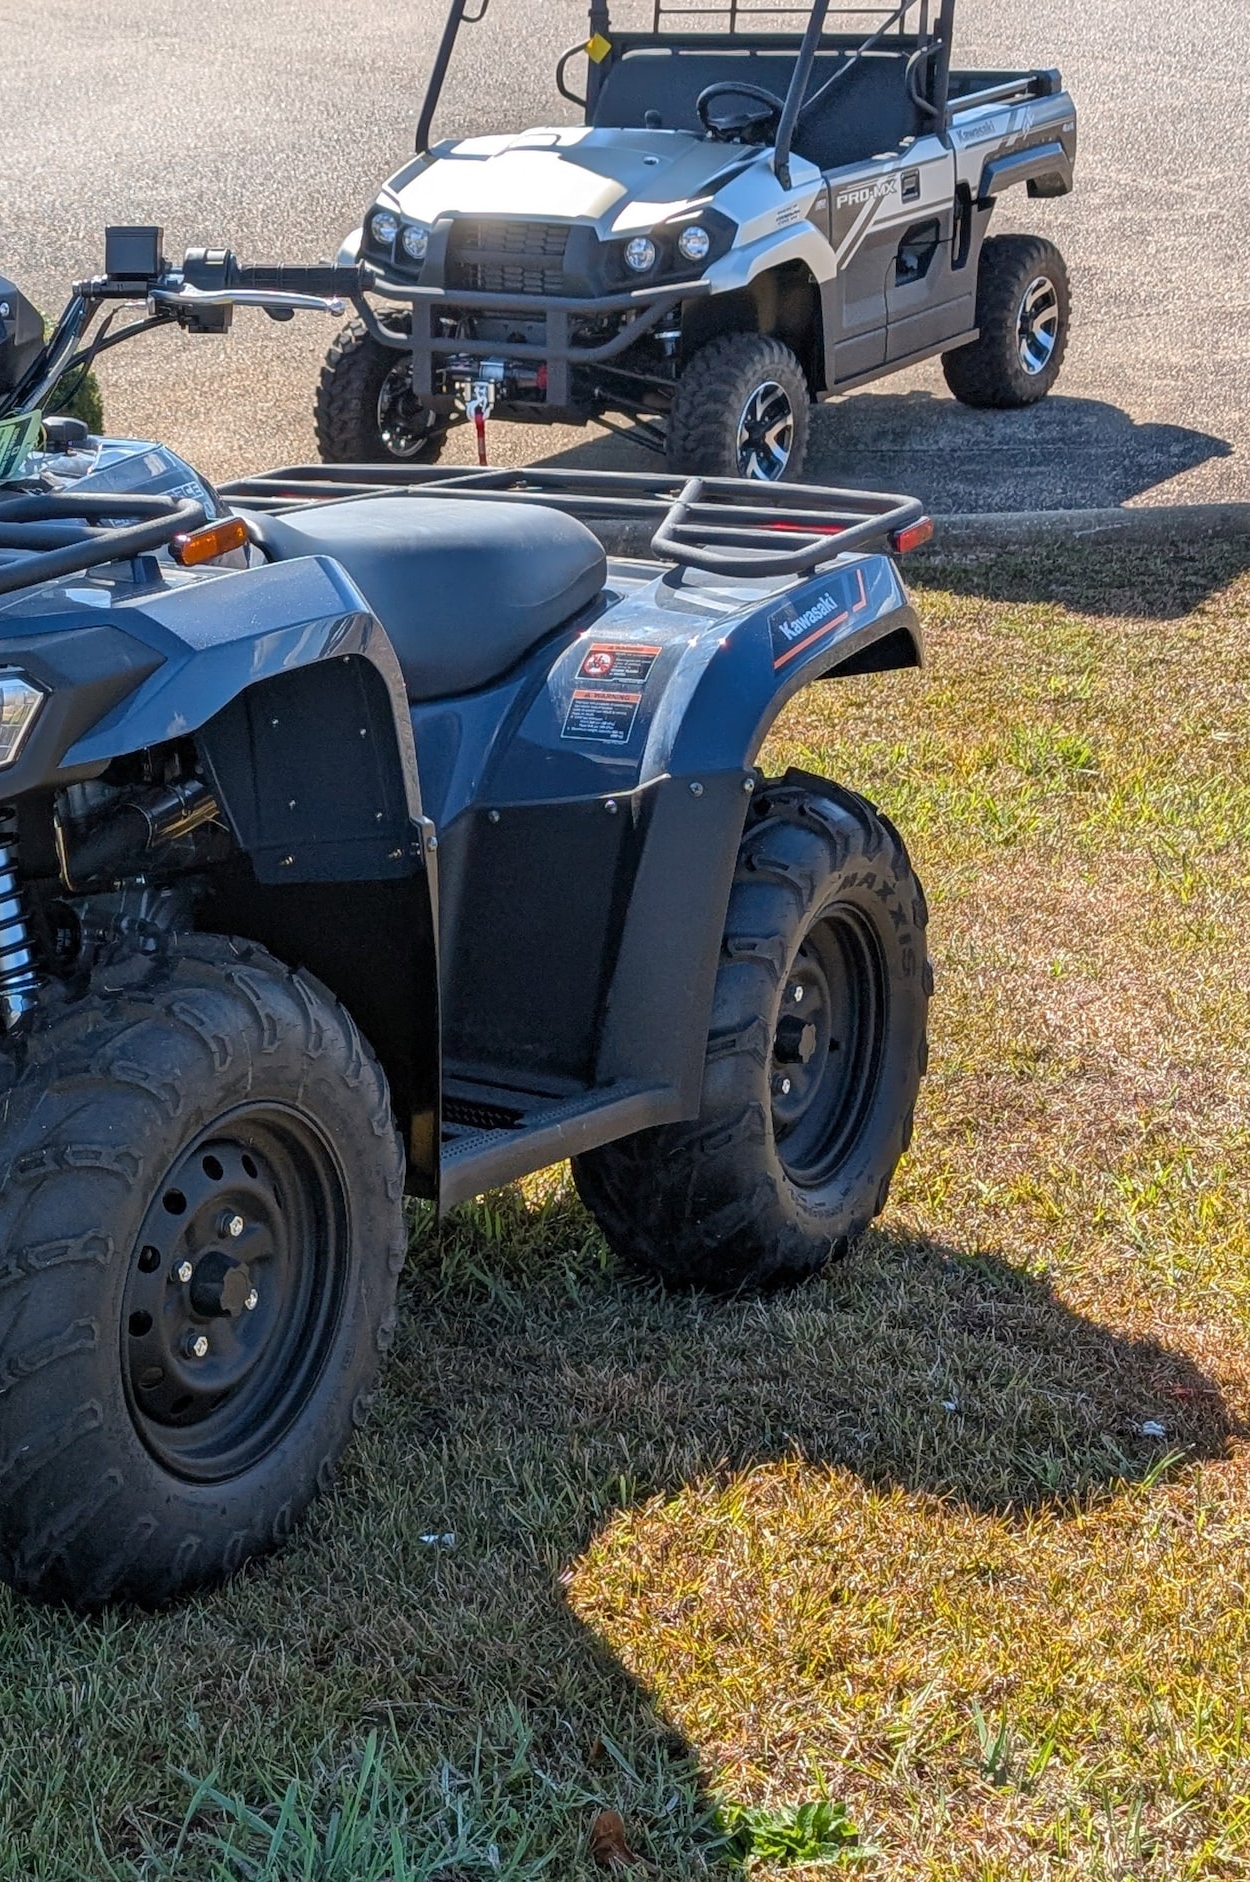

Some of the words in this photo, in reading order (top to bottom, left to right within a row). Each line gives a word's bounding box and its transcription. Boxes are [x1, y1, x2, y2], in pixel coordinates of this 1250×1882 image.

[956, 120, 995, 142] Kawasaki
[779, 592, 838, 641] Kawasaki
[836, 871, 916, 977] MAXXIS
